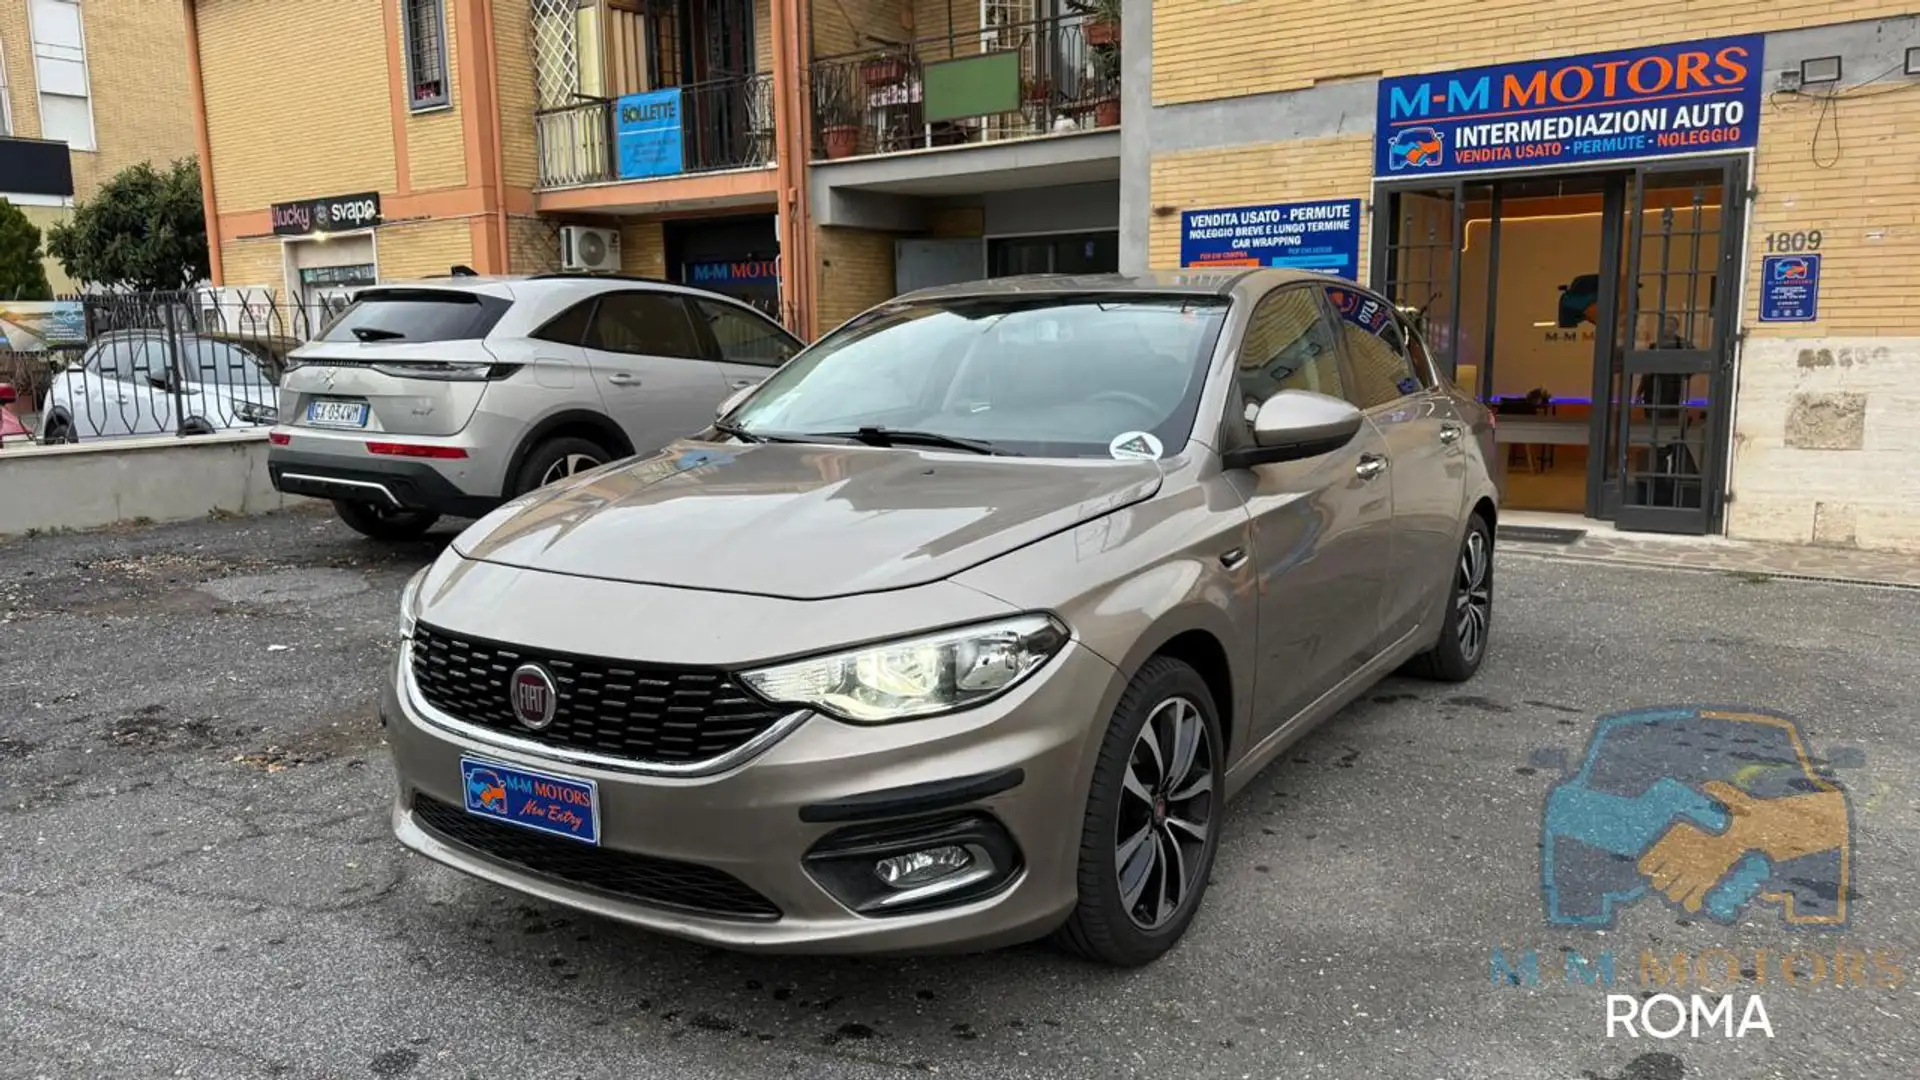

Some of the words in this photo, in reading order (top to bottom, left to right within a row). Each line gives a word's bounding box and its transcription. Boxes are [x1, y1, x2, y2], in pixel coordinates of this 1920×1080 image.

[1389, 76, 1491, 119] M-M
[1503, 46, 1749, 109] MOTORS
[622, 102, 677, 123] BOLLETTE
[1454, 108, 1666, 149] INTERMEDIAZIONI
[1672, 100, 1744, 129] AUTO
[1455, 148, 1512, 165] VENDITA
[1516, 142, 1562, 160] USATO
[1573, 134, 1646, 156] PERMUTE
[1657, 126, 1741, 148] NOLEGGIO
[331, 200, 376, 225] svapo
[1190, 214, 1238, 228] VENDITA
[1241, 209, 1280, 225] USATO
[1290, 204, 1351, 221] PERMUTE
[1189, 227, 1234, 240] NOLEGGIO
[1235, 225, 1265, 238] BREVE
[1266, 224, 1272, 234] E
[1273, 222, 1305, 234] LUNGO
[1307, 219, 1350, 232] TERMINE
[1231, 238, 1251, 249] CAR
[1252, 235, 1301, 248] WRAPPING
[1766, 230, 1822, 252] 1809
[694, 263, 728, 280] M-M
[519, 682, 545, 713] FIAT
[505, 774, 533, 793] M-M
[535, 782, 590, 807] MOTORS
[519, 798, 545, 816] New
[548, 805, 583, 831] Entry
